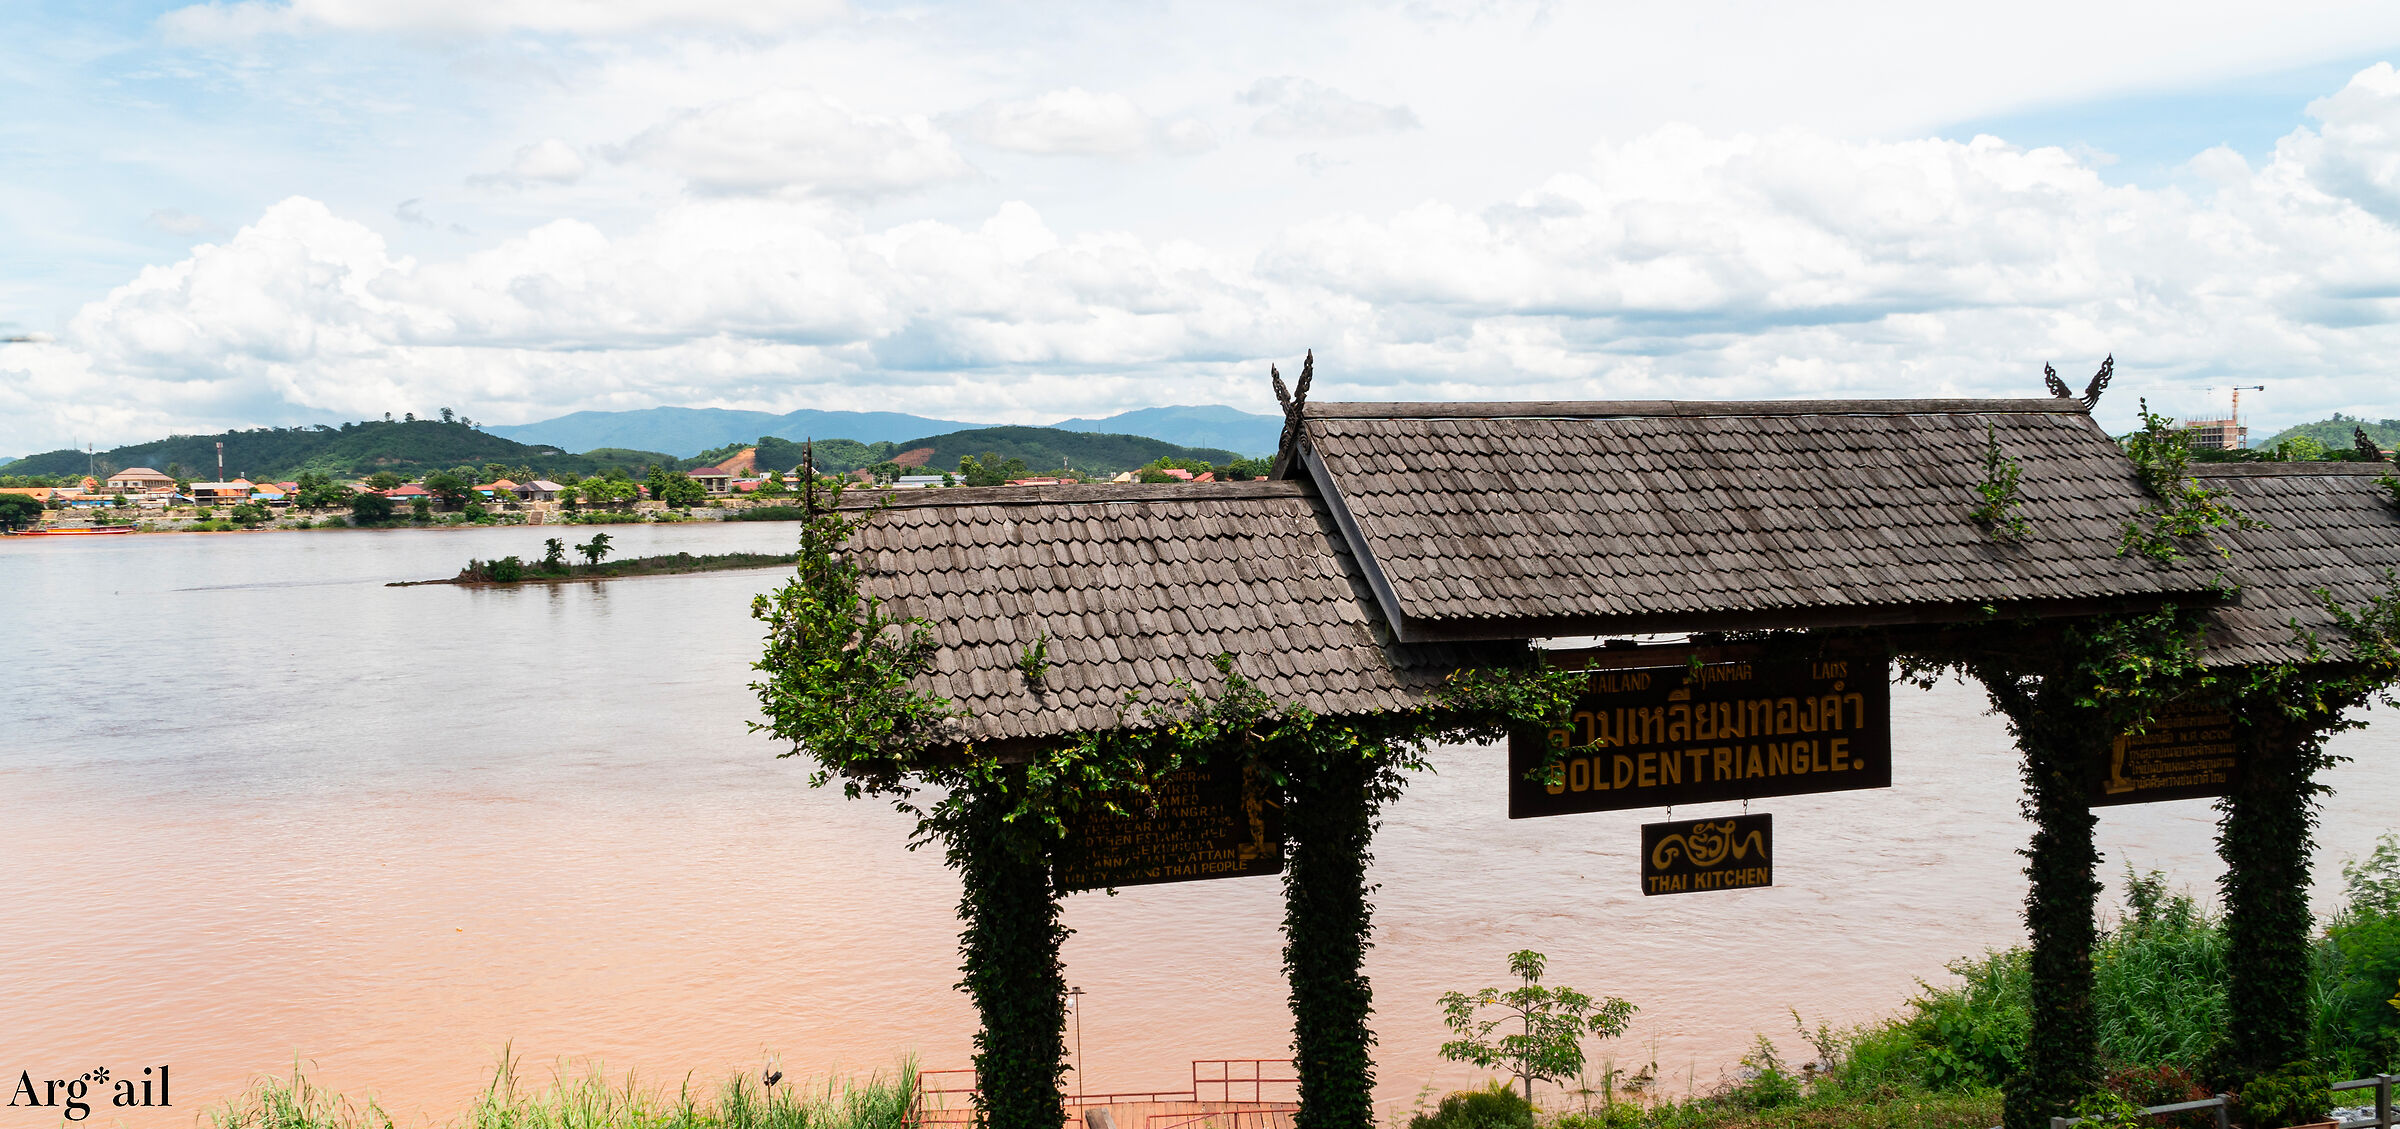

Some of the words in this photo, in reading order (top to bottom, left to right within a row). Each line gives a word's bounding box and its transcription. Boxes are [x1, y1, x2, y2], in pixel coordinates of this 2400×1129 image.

[1577, 673, 1651, 694] HAILAND
[1812, 661, 1848, 680] LAOS
[1154, 794, 1199, 807] AMED
[1188, 849, 1235, 862] ATTAIN
[1164, 864, 1197, 876] THAI
[1202, 860, 1247, 873] PEOPLE
[1648, 874, 1687, 893] THAI
[1694, 866, 1769, 889] KITCHEN
